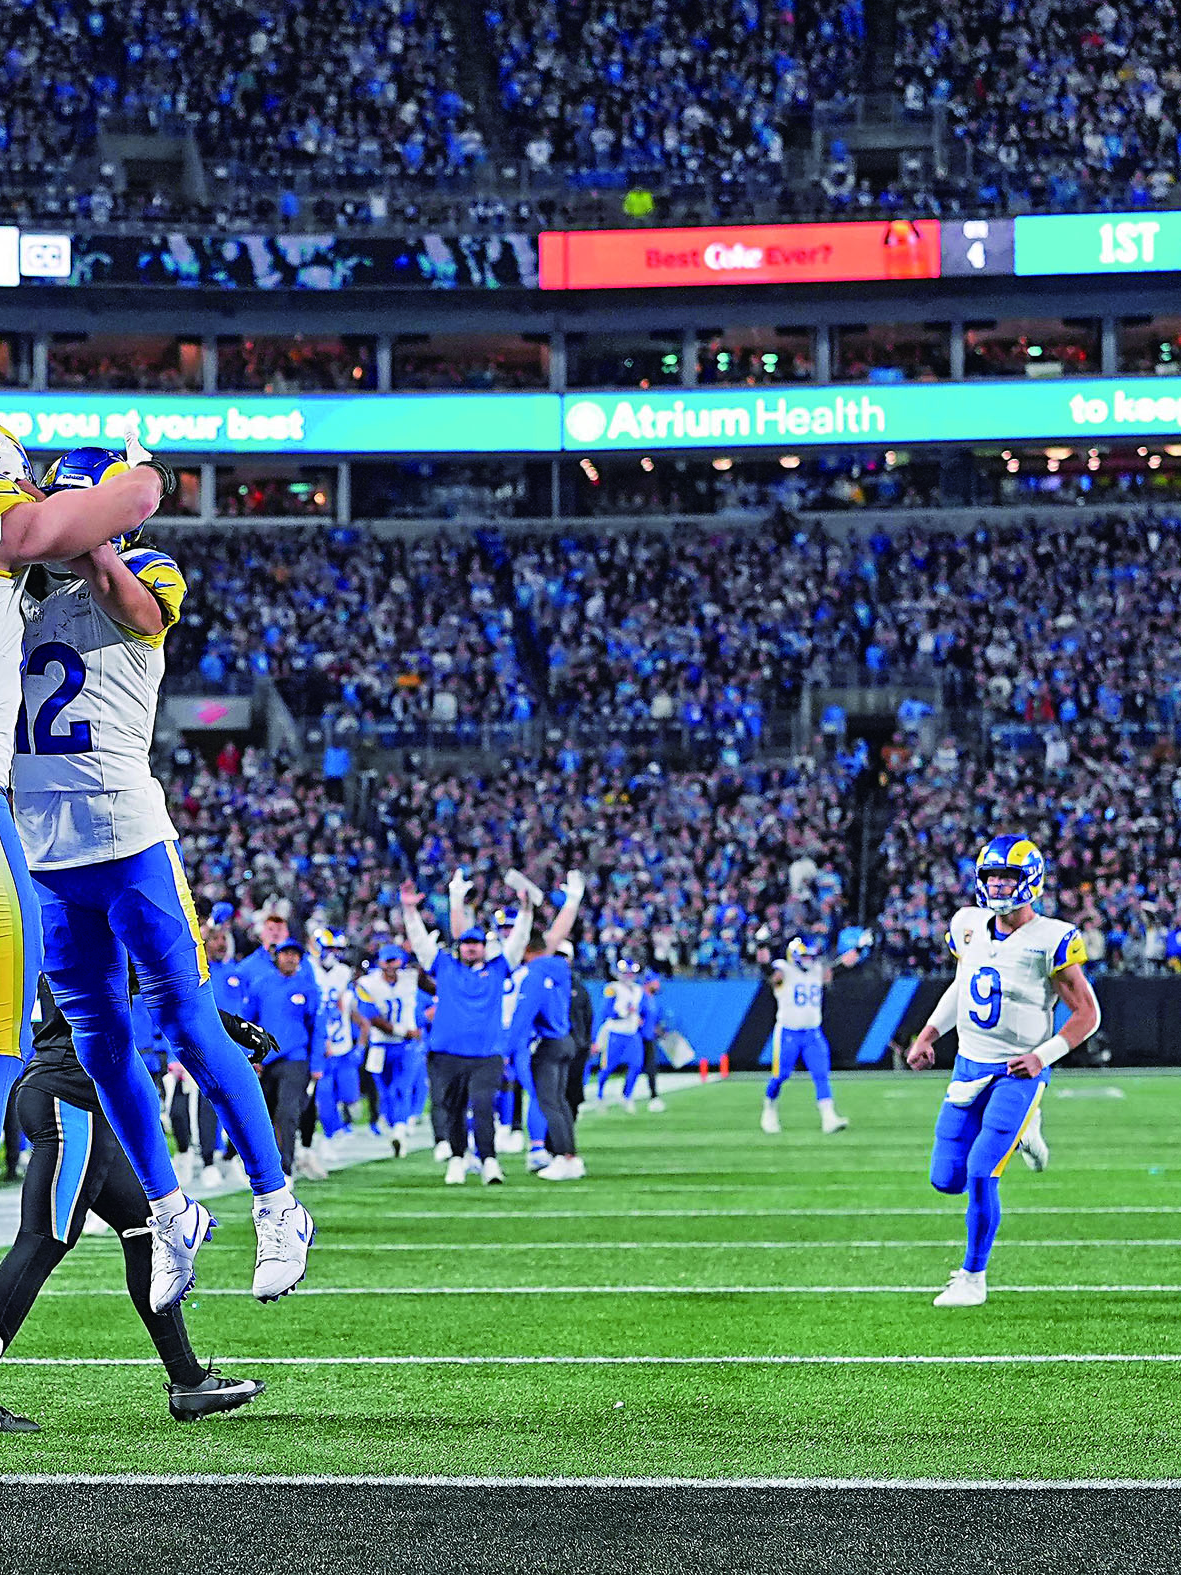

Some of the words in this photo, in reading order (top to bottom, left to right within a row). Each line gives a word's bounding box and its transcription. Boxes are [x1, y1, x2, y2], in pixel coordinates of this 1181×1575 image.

[645, 247, 700, 269] Best
[766, 244, 833, 266] Ever?
[1099, 222, 1161, 264] 1ST
[37, 412, 100, 443] you
[145, 413, 223, 446] your
[227, 407, 305, 440] best
[607, 400, 751, 439] Atrium
[755, 396, 886, 435] Health
[1069, 392, 1109, 424] to
[1113, 389, 1181, 428] kee
[969, 966, 1002, 1030] 9
